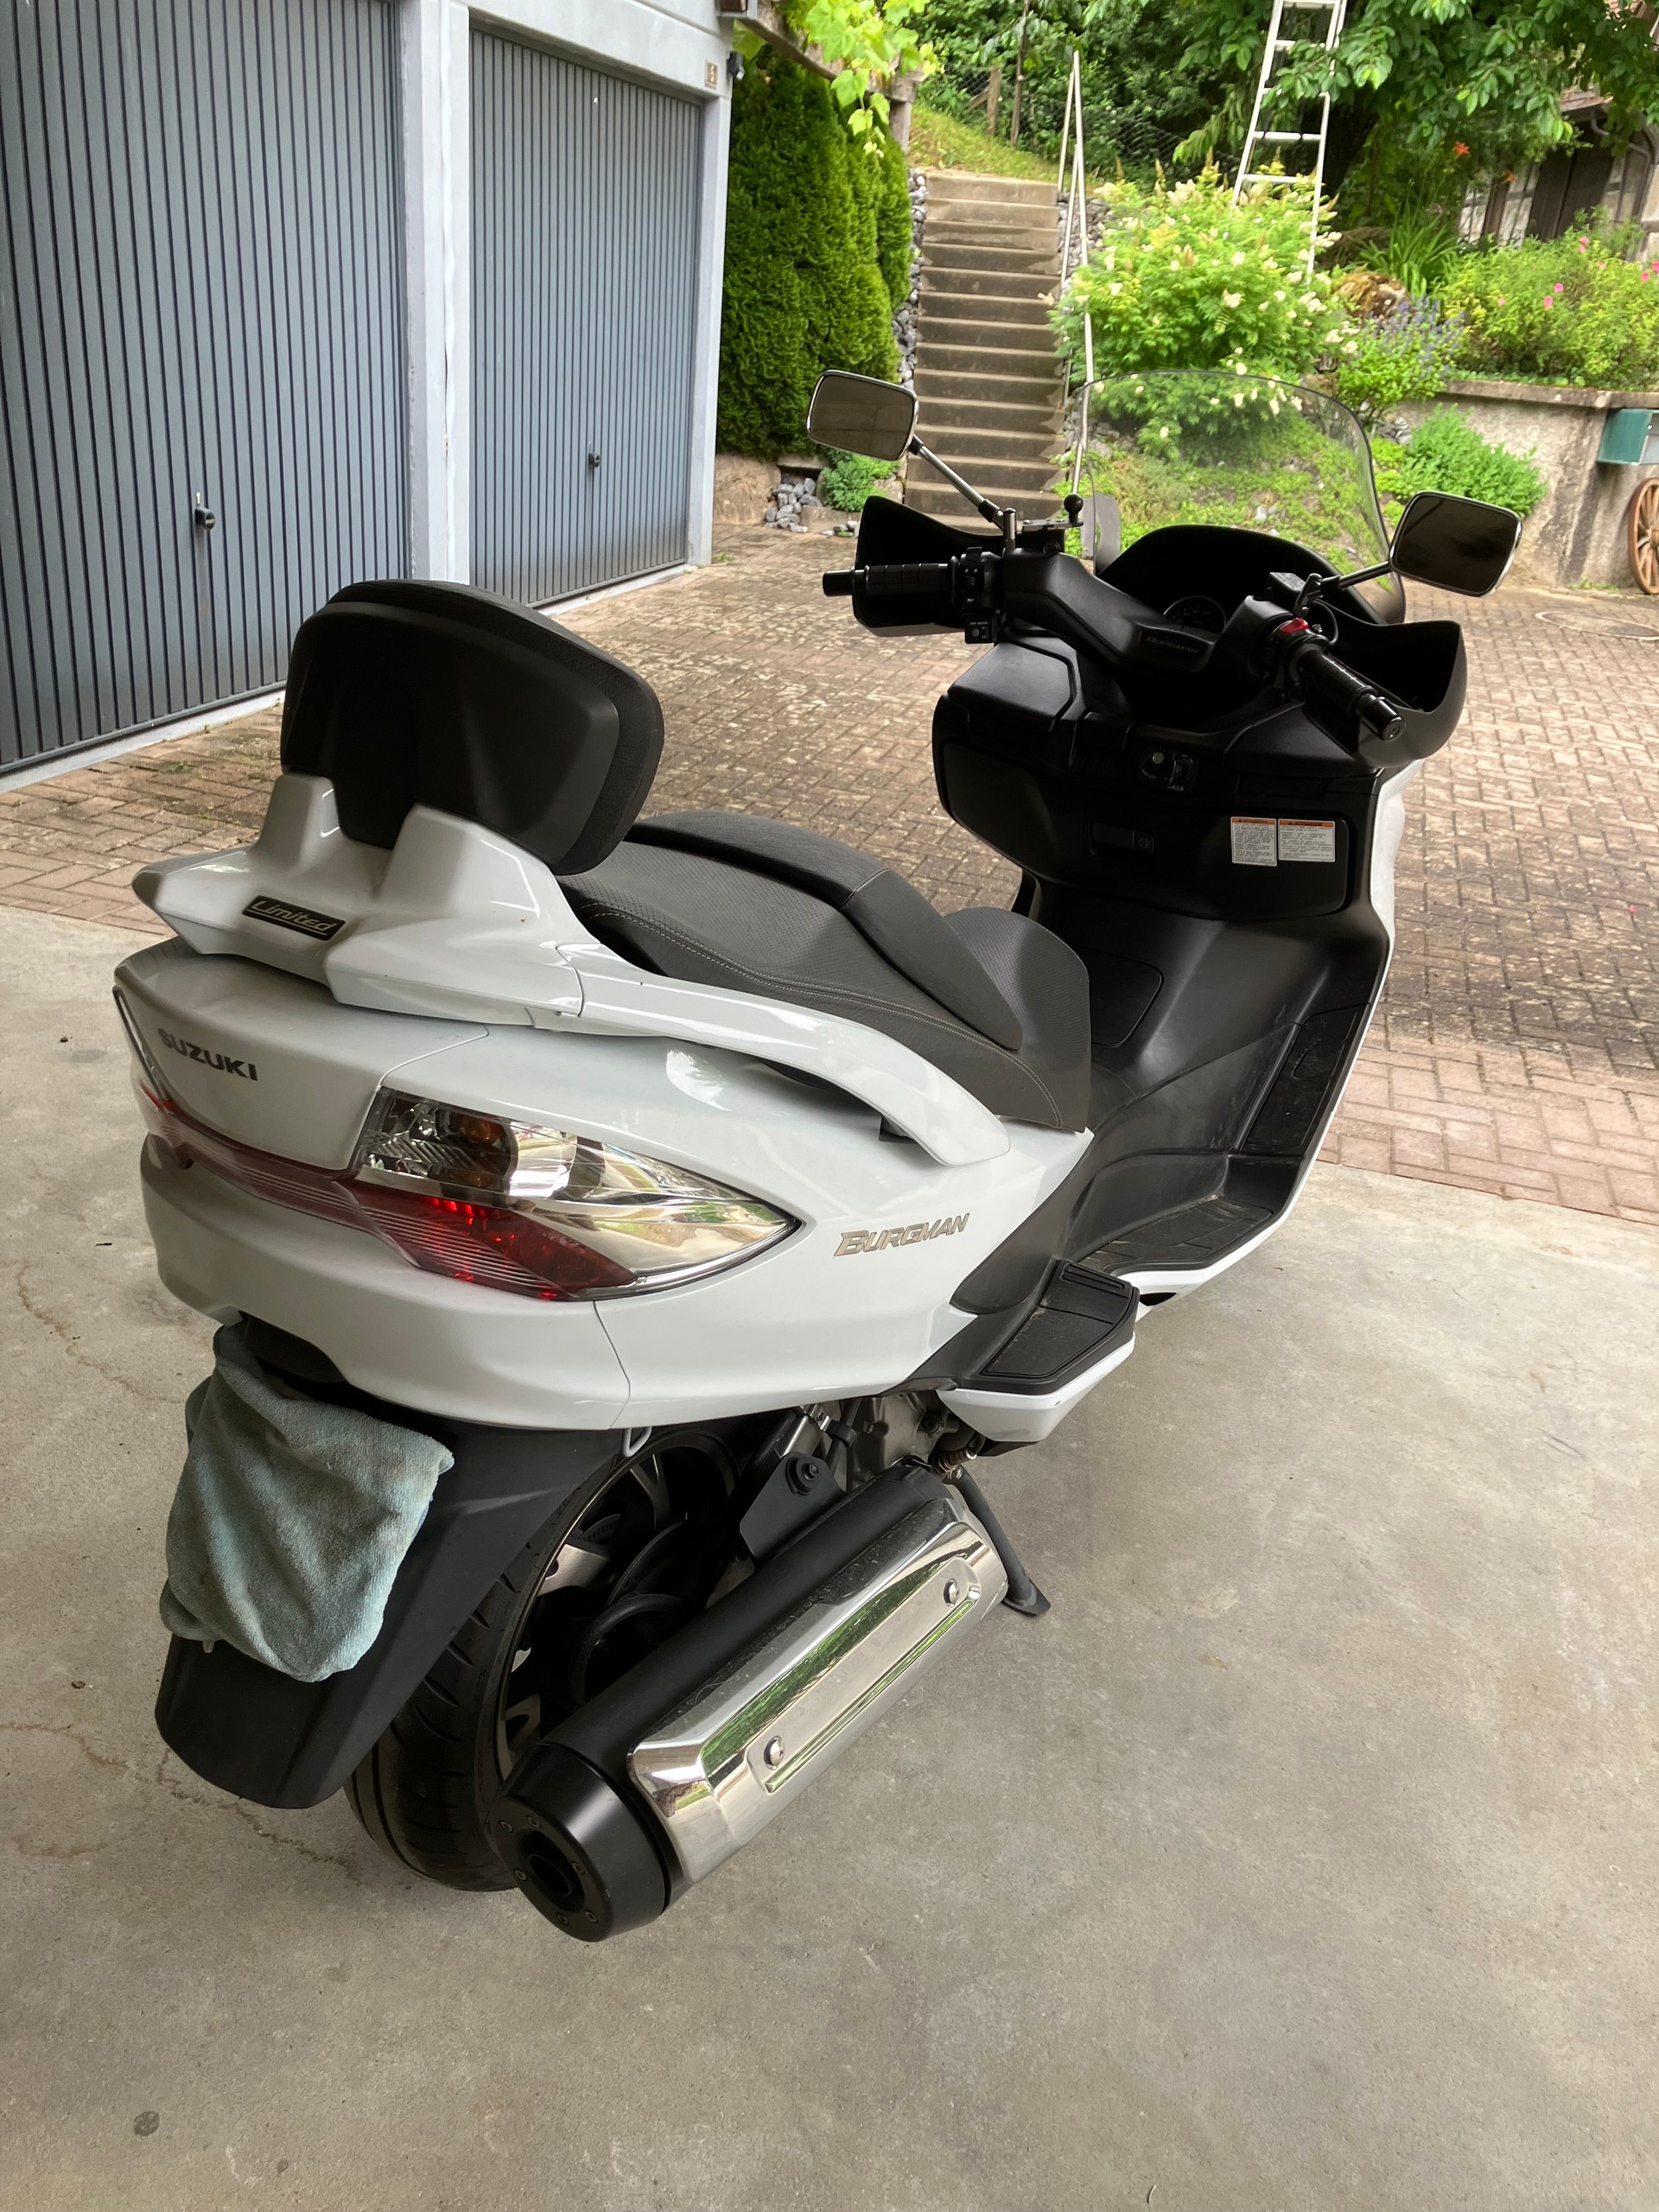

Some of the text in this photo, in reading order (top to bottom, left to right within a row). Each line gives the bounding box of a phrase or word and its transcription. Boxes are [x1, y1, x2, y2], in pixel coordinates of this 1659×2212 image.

[251, 900, 338, 931] Limited
[158, 1028, 258, 1081] SUZUKI
[833, 1212, 970, 1256] BURGMAN
